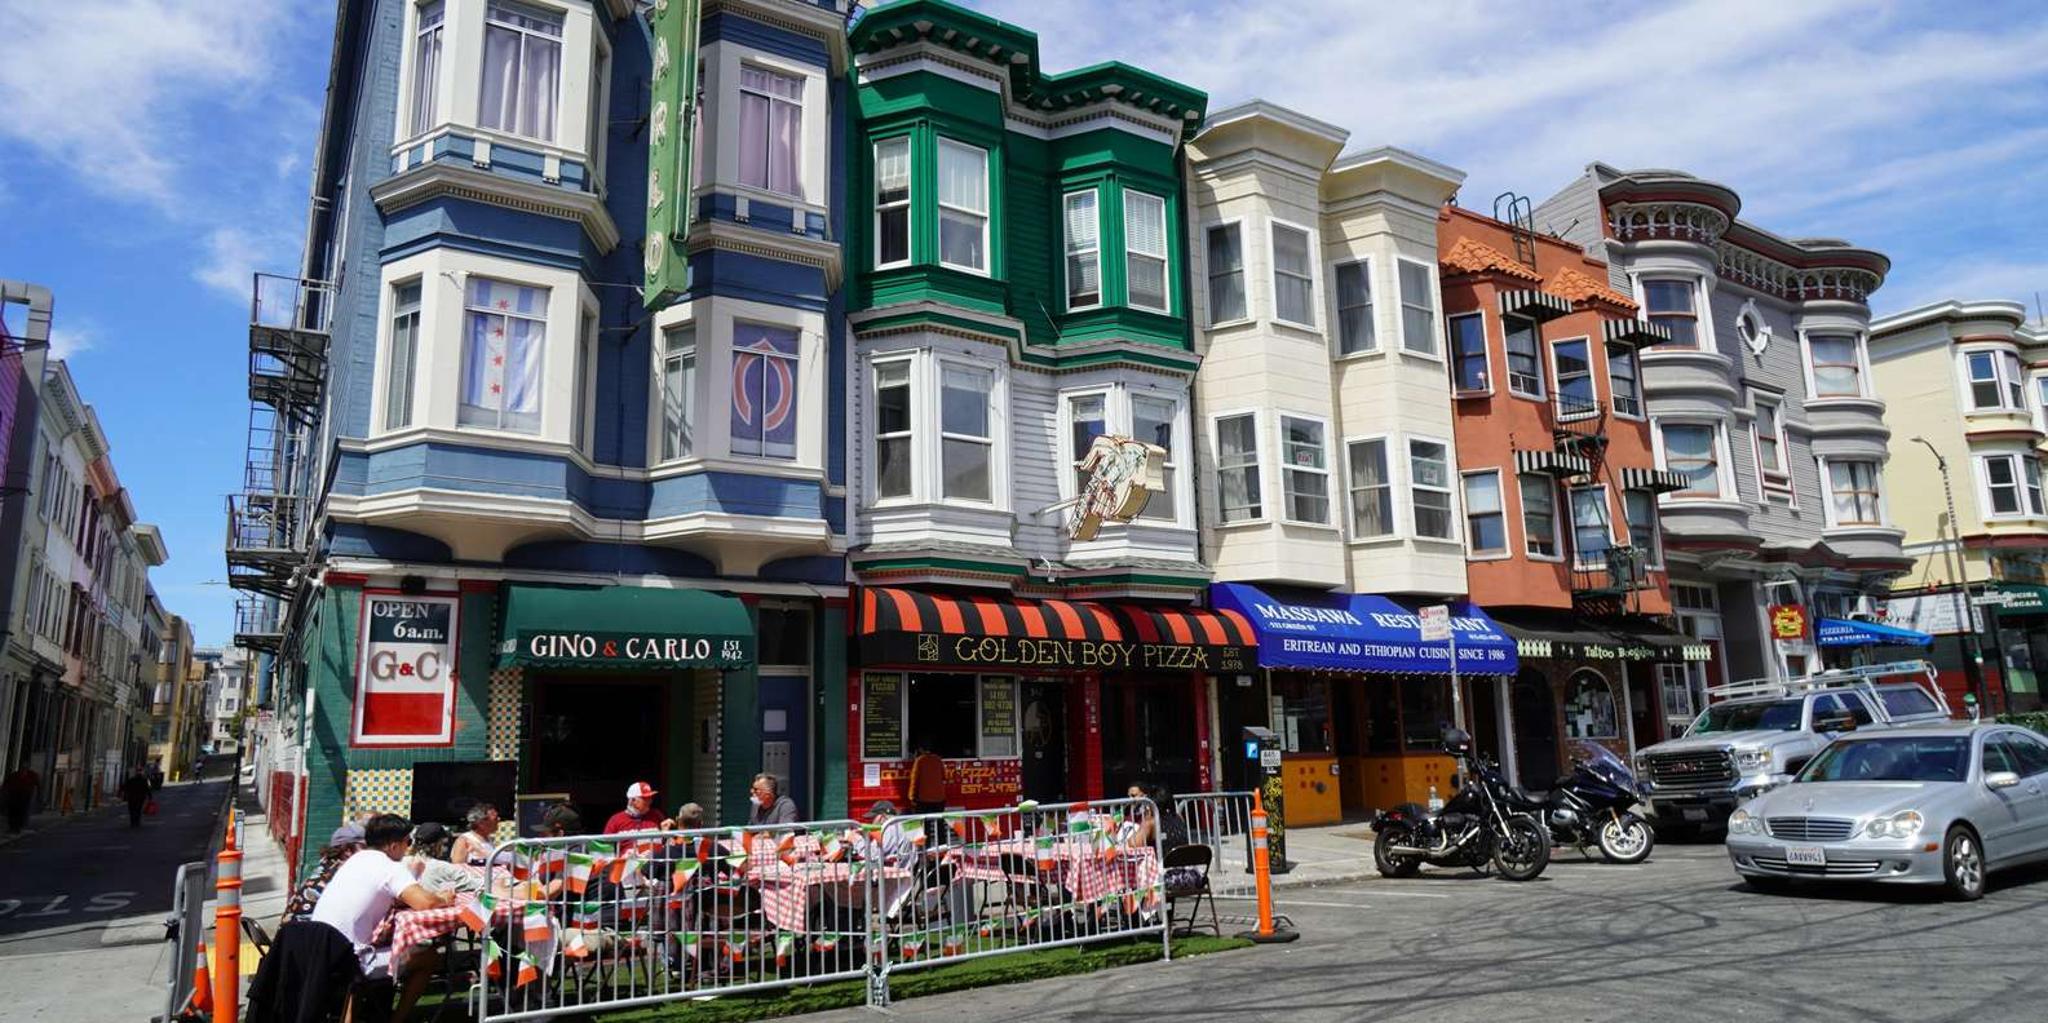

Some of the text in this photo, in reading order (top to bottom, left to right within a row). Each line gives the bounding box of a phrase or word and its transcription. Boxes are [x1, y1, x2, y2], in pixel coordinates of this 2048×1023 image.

[373, 602, 428, 618] OPEN
[1254, 603, 1362, 626] MASSAWA
[531, 634, 596, 657] GINO
[602, 641, 618, 656] &
[625, 638, 711, 661] CARLO
[724, 640, 739, 650] EST
[955, 638, 1209, 669] GOLDEN BOY PIZZA
[1283, 639, 1506, 661] ERITREAN AND ETHIOPIAN CUISIN SINCE 1986
[1584, 645, 1615, 660] Tattoo
[721, 650, 743, 660] 1942
